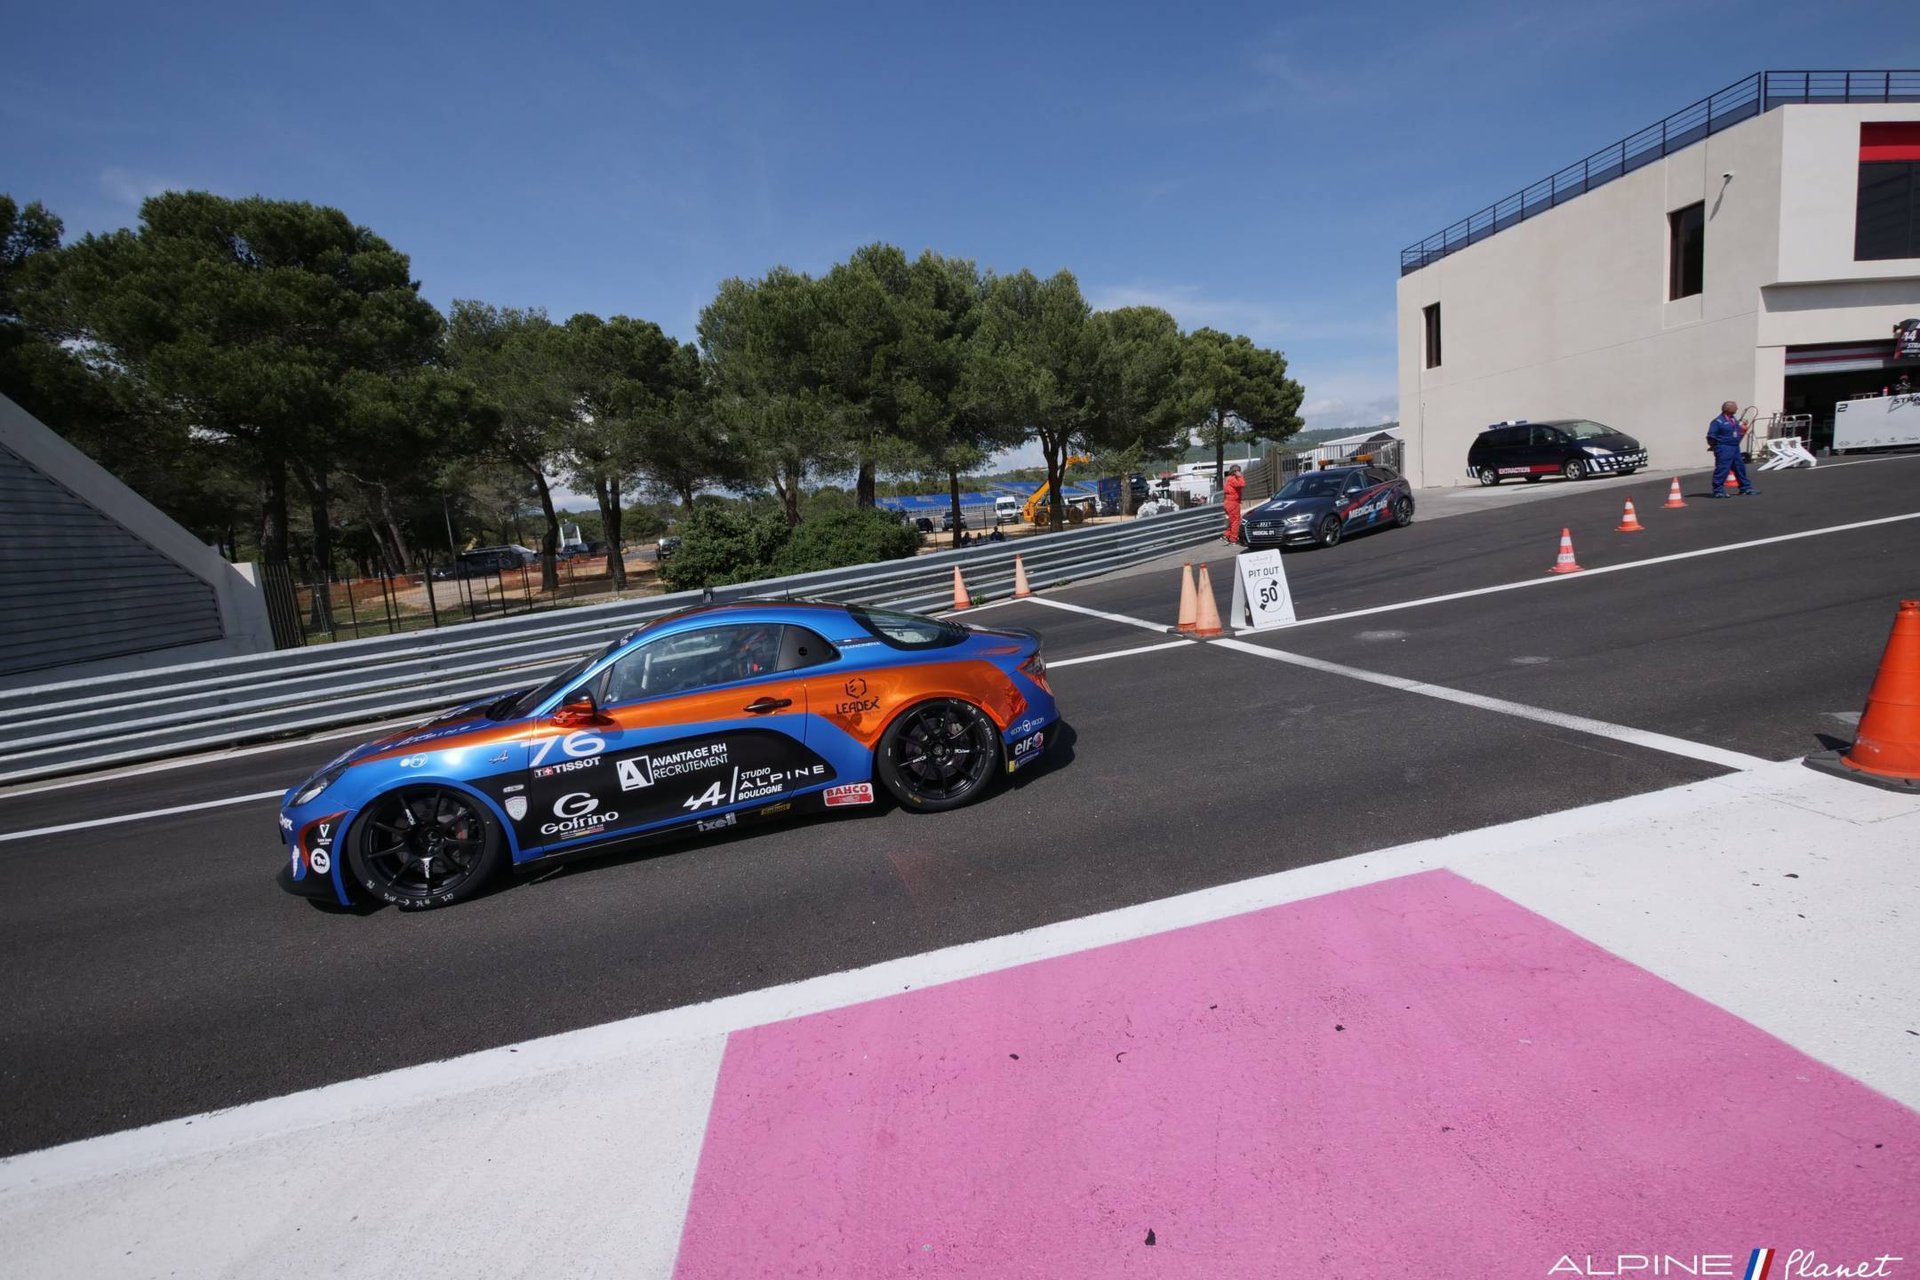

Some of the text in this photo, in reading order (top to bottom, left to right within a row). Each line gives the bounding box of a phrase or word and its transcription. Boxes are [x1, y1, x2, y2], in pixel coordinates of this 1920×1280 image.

[1837, 403, 1848, 413] 2
[1498, 466, 1531, 475] EXTRACTION
[1348, 499, 1388, 519] MEDICAL CAR
[1248, 566, 1280, 578] PIT OUT
[1260, 586, 1278, 604] 50
[836, 697, 880, 715] LEADEX
[520, 730, 606, 768] 76
[652, 742, 728, 768] AVANTAGE RH
[1014, 737, 1033, 756] elf
[553, 756, 601, 775] TISSOT
[653, 753, 729, 780] RECRUTEMENT
[740, 767, 771, 780] STUDIO
[740, 764, 825, 790] ALPINE
[738, 783, 783, 800] BOULOGNE
[826, 784, 869, 797] BAHCO
[540, 811, 619, 835] Gofrino
